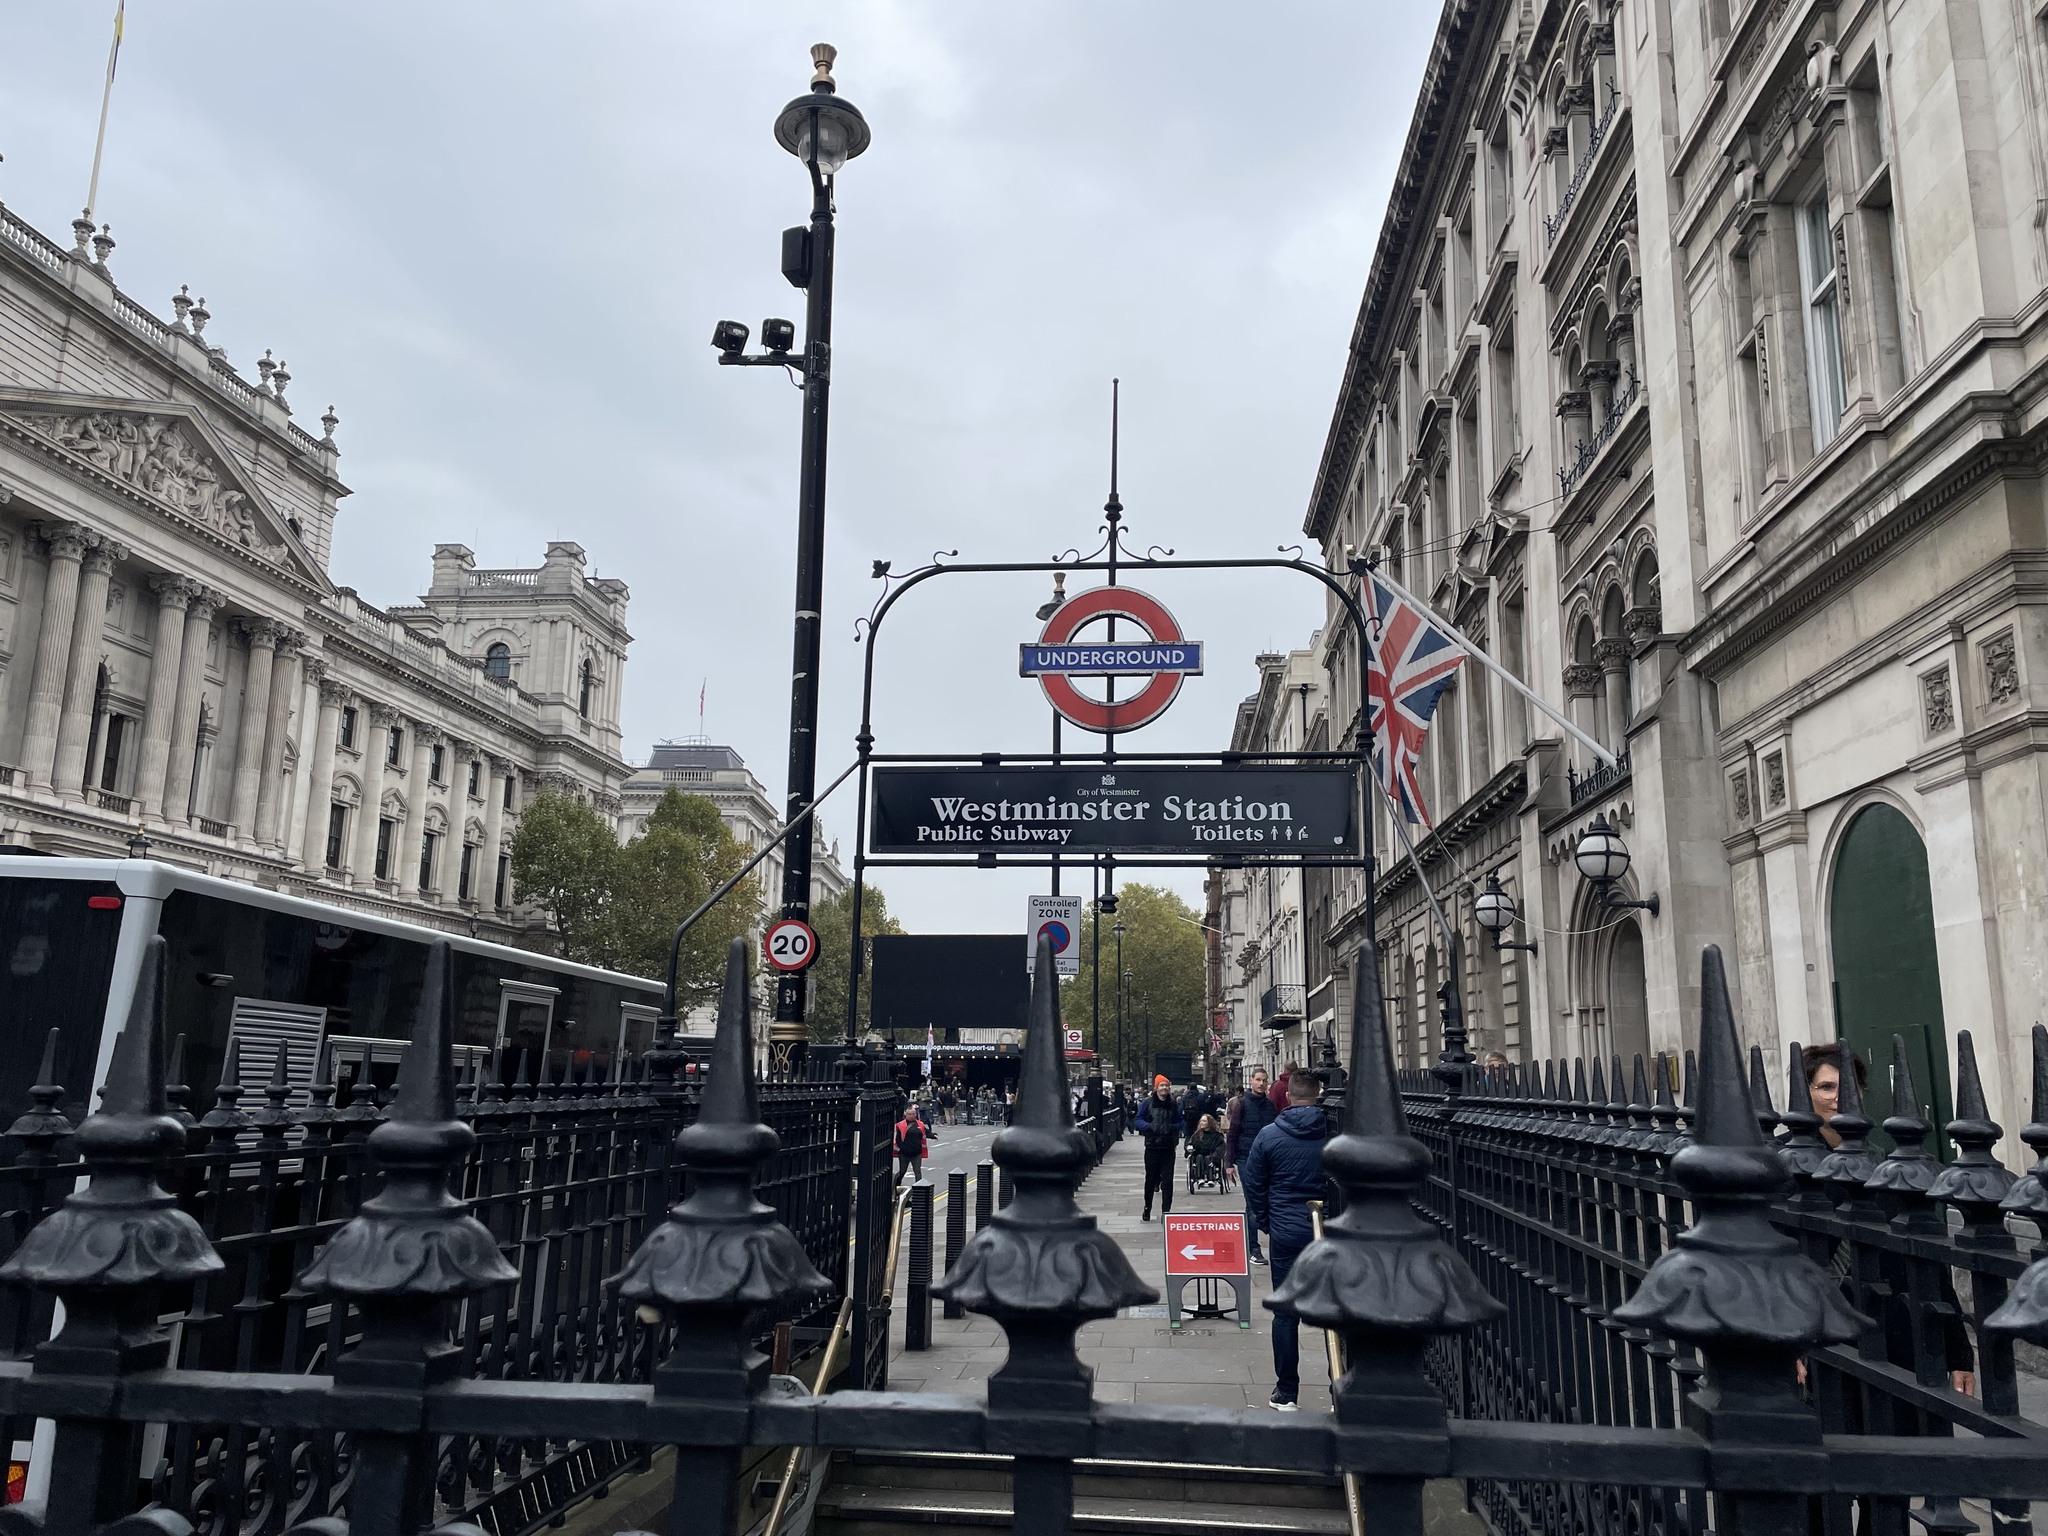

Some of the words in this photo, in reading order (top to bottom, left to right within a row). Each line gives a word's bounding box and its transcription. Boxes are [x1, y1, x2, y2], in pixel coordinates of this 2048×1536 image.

[1037, 650, 1185, 666] UNDERGROUND
[1077, 788, 1090, 797] City
[1091, 788, 1099, 796] of
[1100, 788, 1140, 796] Westminster
[930, 795, 1150, 822] Westminster
[1163, 795, 1293, 821] Station
[917, 824, 983, 841] Public
[990, 824, 1072, 845] Subway
[1191, 824, 1264, 841] Toilets
[1032, 899, 1077, 907] Controlled
[1038, 909, 1070, 918] ZONE
[774, 935, 807, 955] 20
[1170, 1222, 1240, 1231] PEDESTRIANS
